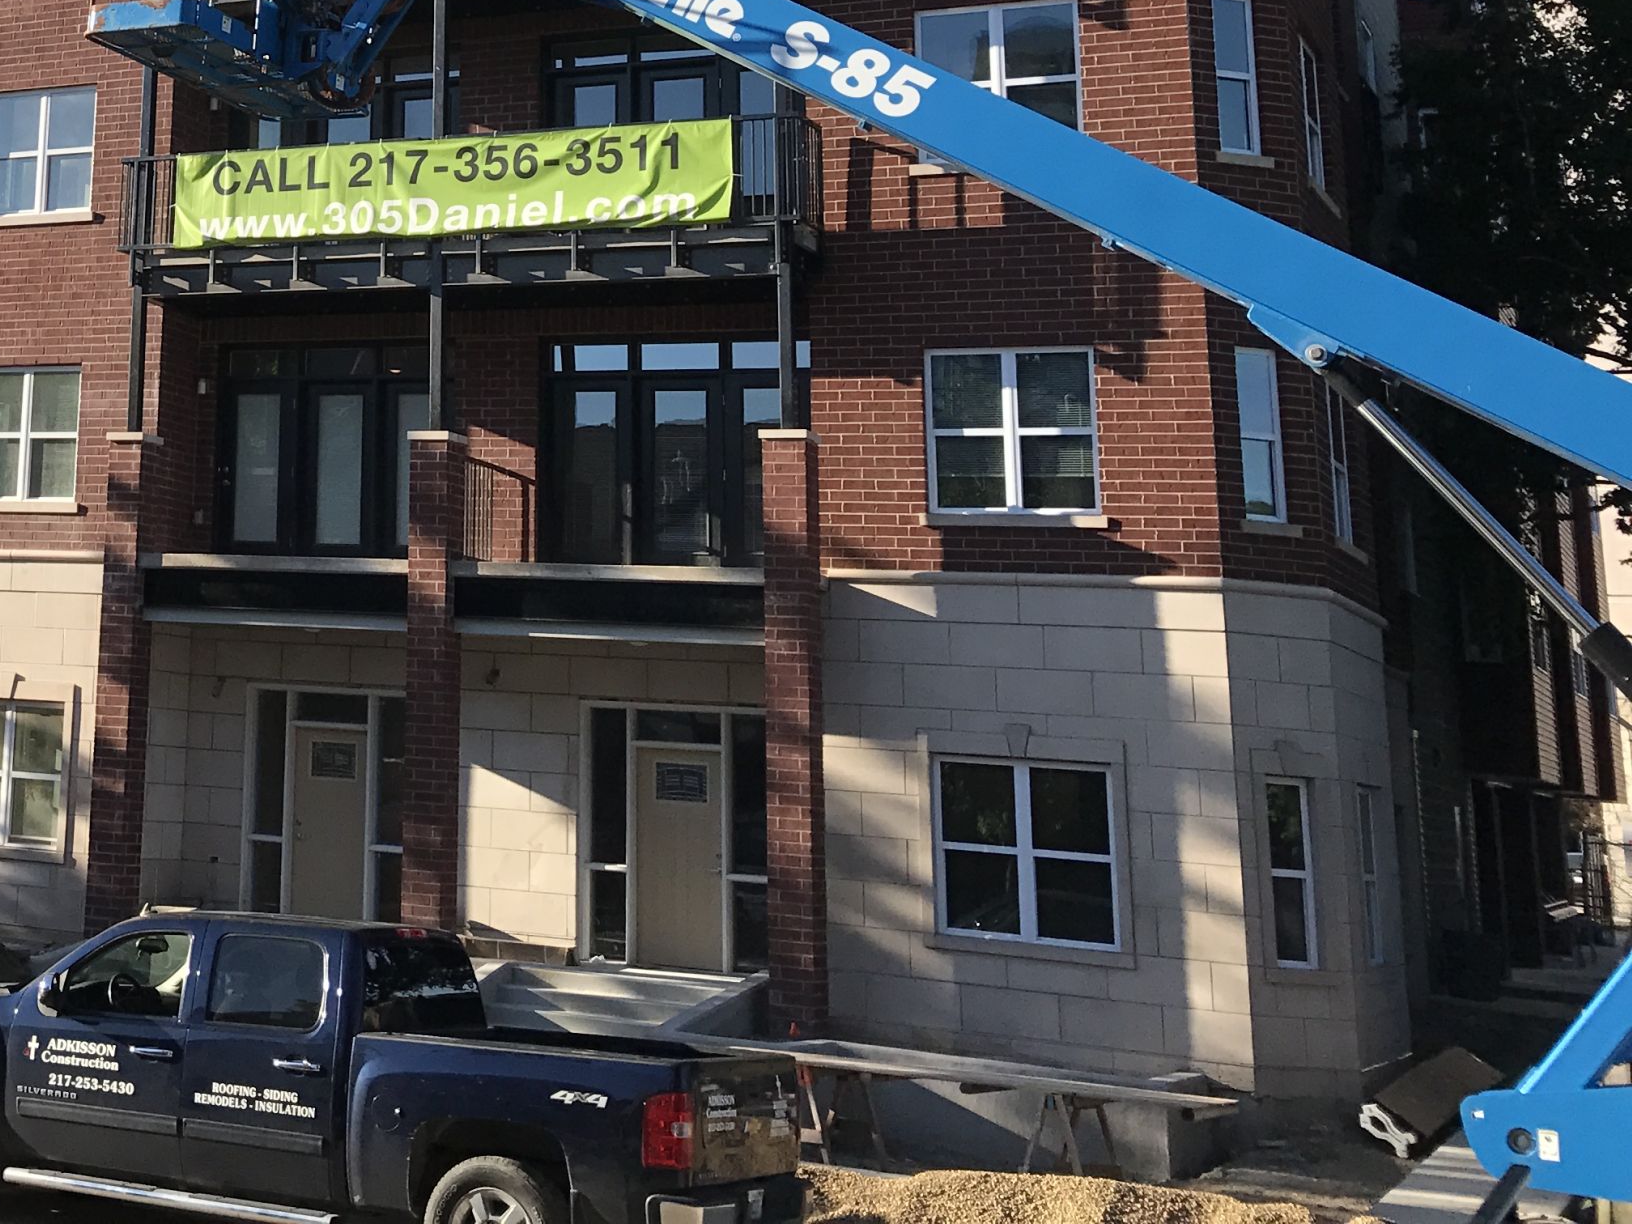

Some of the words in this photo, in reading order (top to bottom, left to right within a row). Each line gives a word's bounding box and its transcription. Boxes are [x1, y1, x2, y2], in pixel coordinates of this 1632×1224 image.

[770, 19, 938, 118] S-85
[211, 154, 330, 197] CALL
[347, 130, 683, 189] 217-356-3511
[198, 186, 697, 242] www.305Daniel.com
[46, 1037, 117, 1057] ADKISSON
[41, 1050, 120, 1072] Construction
[17, 1084, 77, 1100] SILVERADO
[48, 1072, 135, 1096] 217-253-5430
[211, 1081, 257, 1098] ROOFING
[262, 1087, 299, 1104] SIDING
[194, 1092, 248, 1110] REMODELS
[254, 1099, 316, 1119] INSULATION
